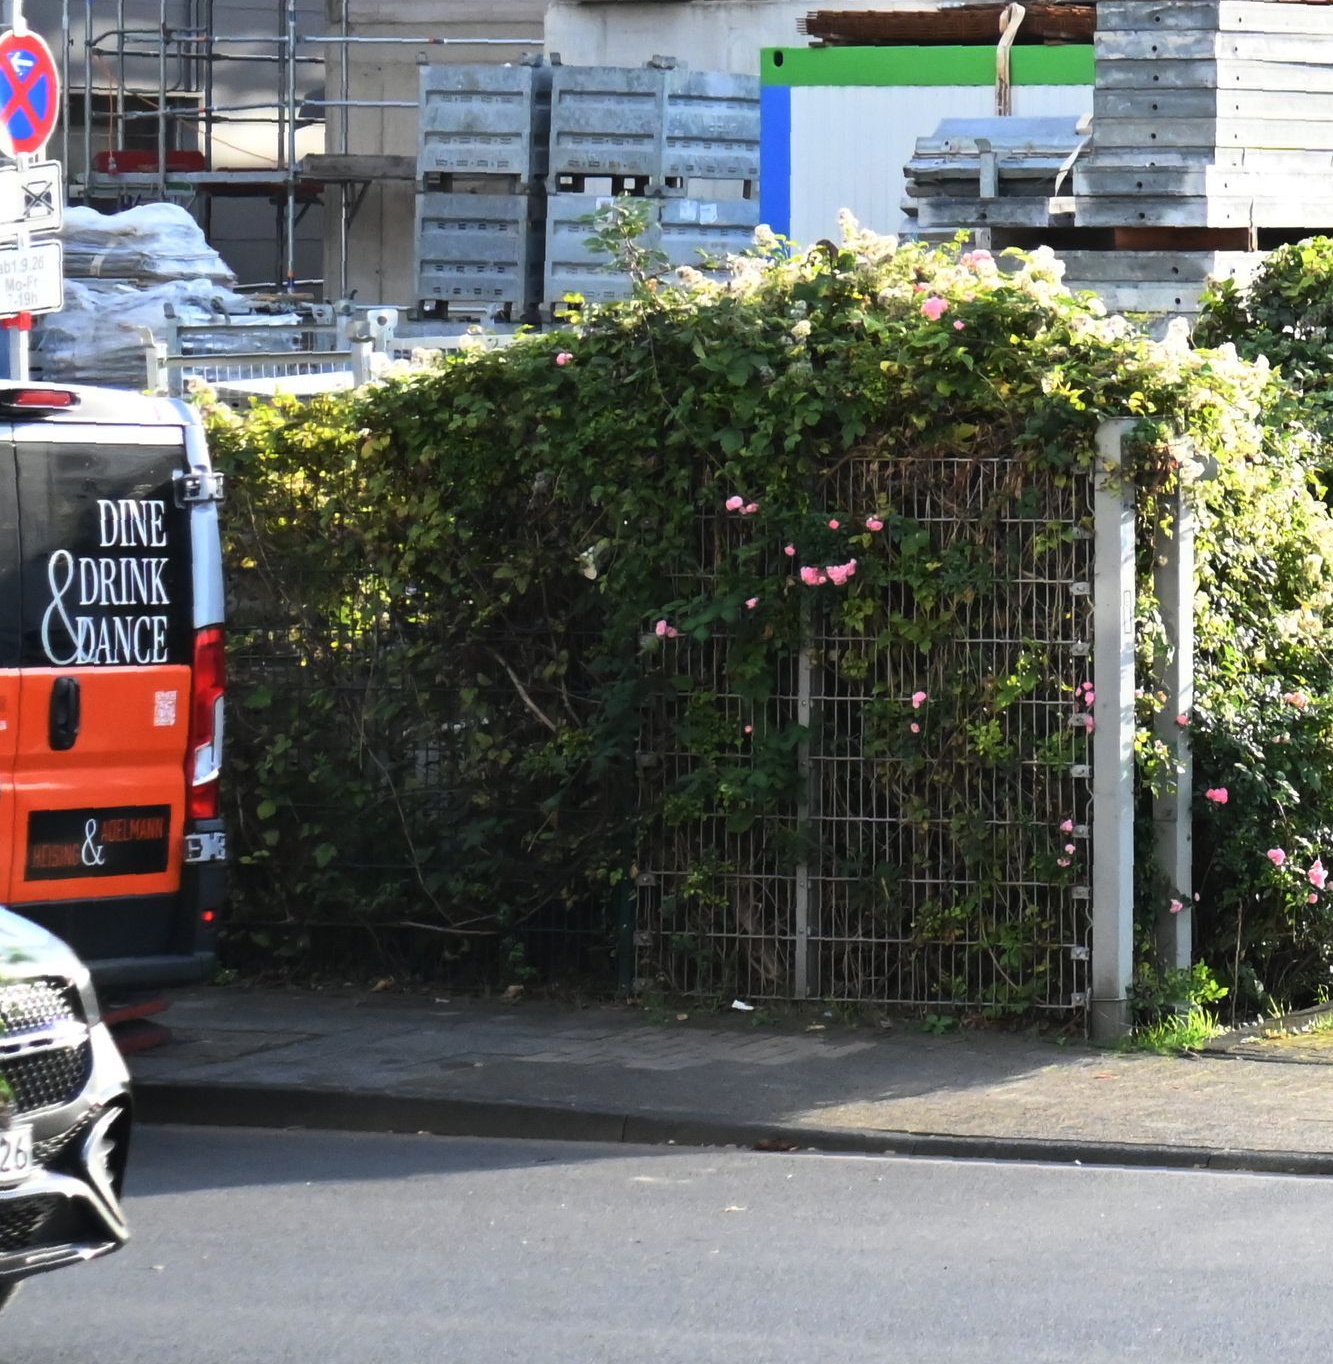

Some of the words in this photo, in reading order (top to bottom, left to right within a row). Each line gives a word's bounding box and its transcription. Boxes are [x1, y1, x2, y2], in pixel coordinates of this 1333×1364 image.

[97, 499, 168, 548] DINE
[78, 557, 171, 606] DRINK
[41, 549, 97, 665] &
[75, 615, 169, 664] DANCE
[81, 818, 105, 866] &
